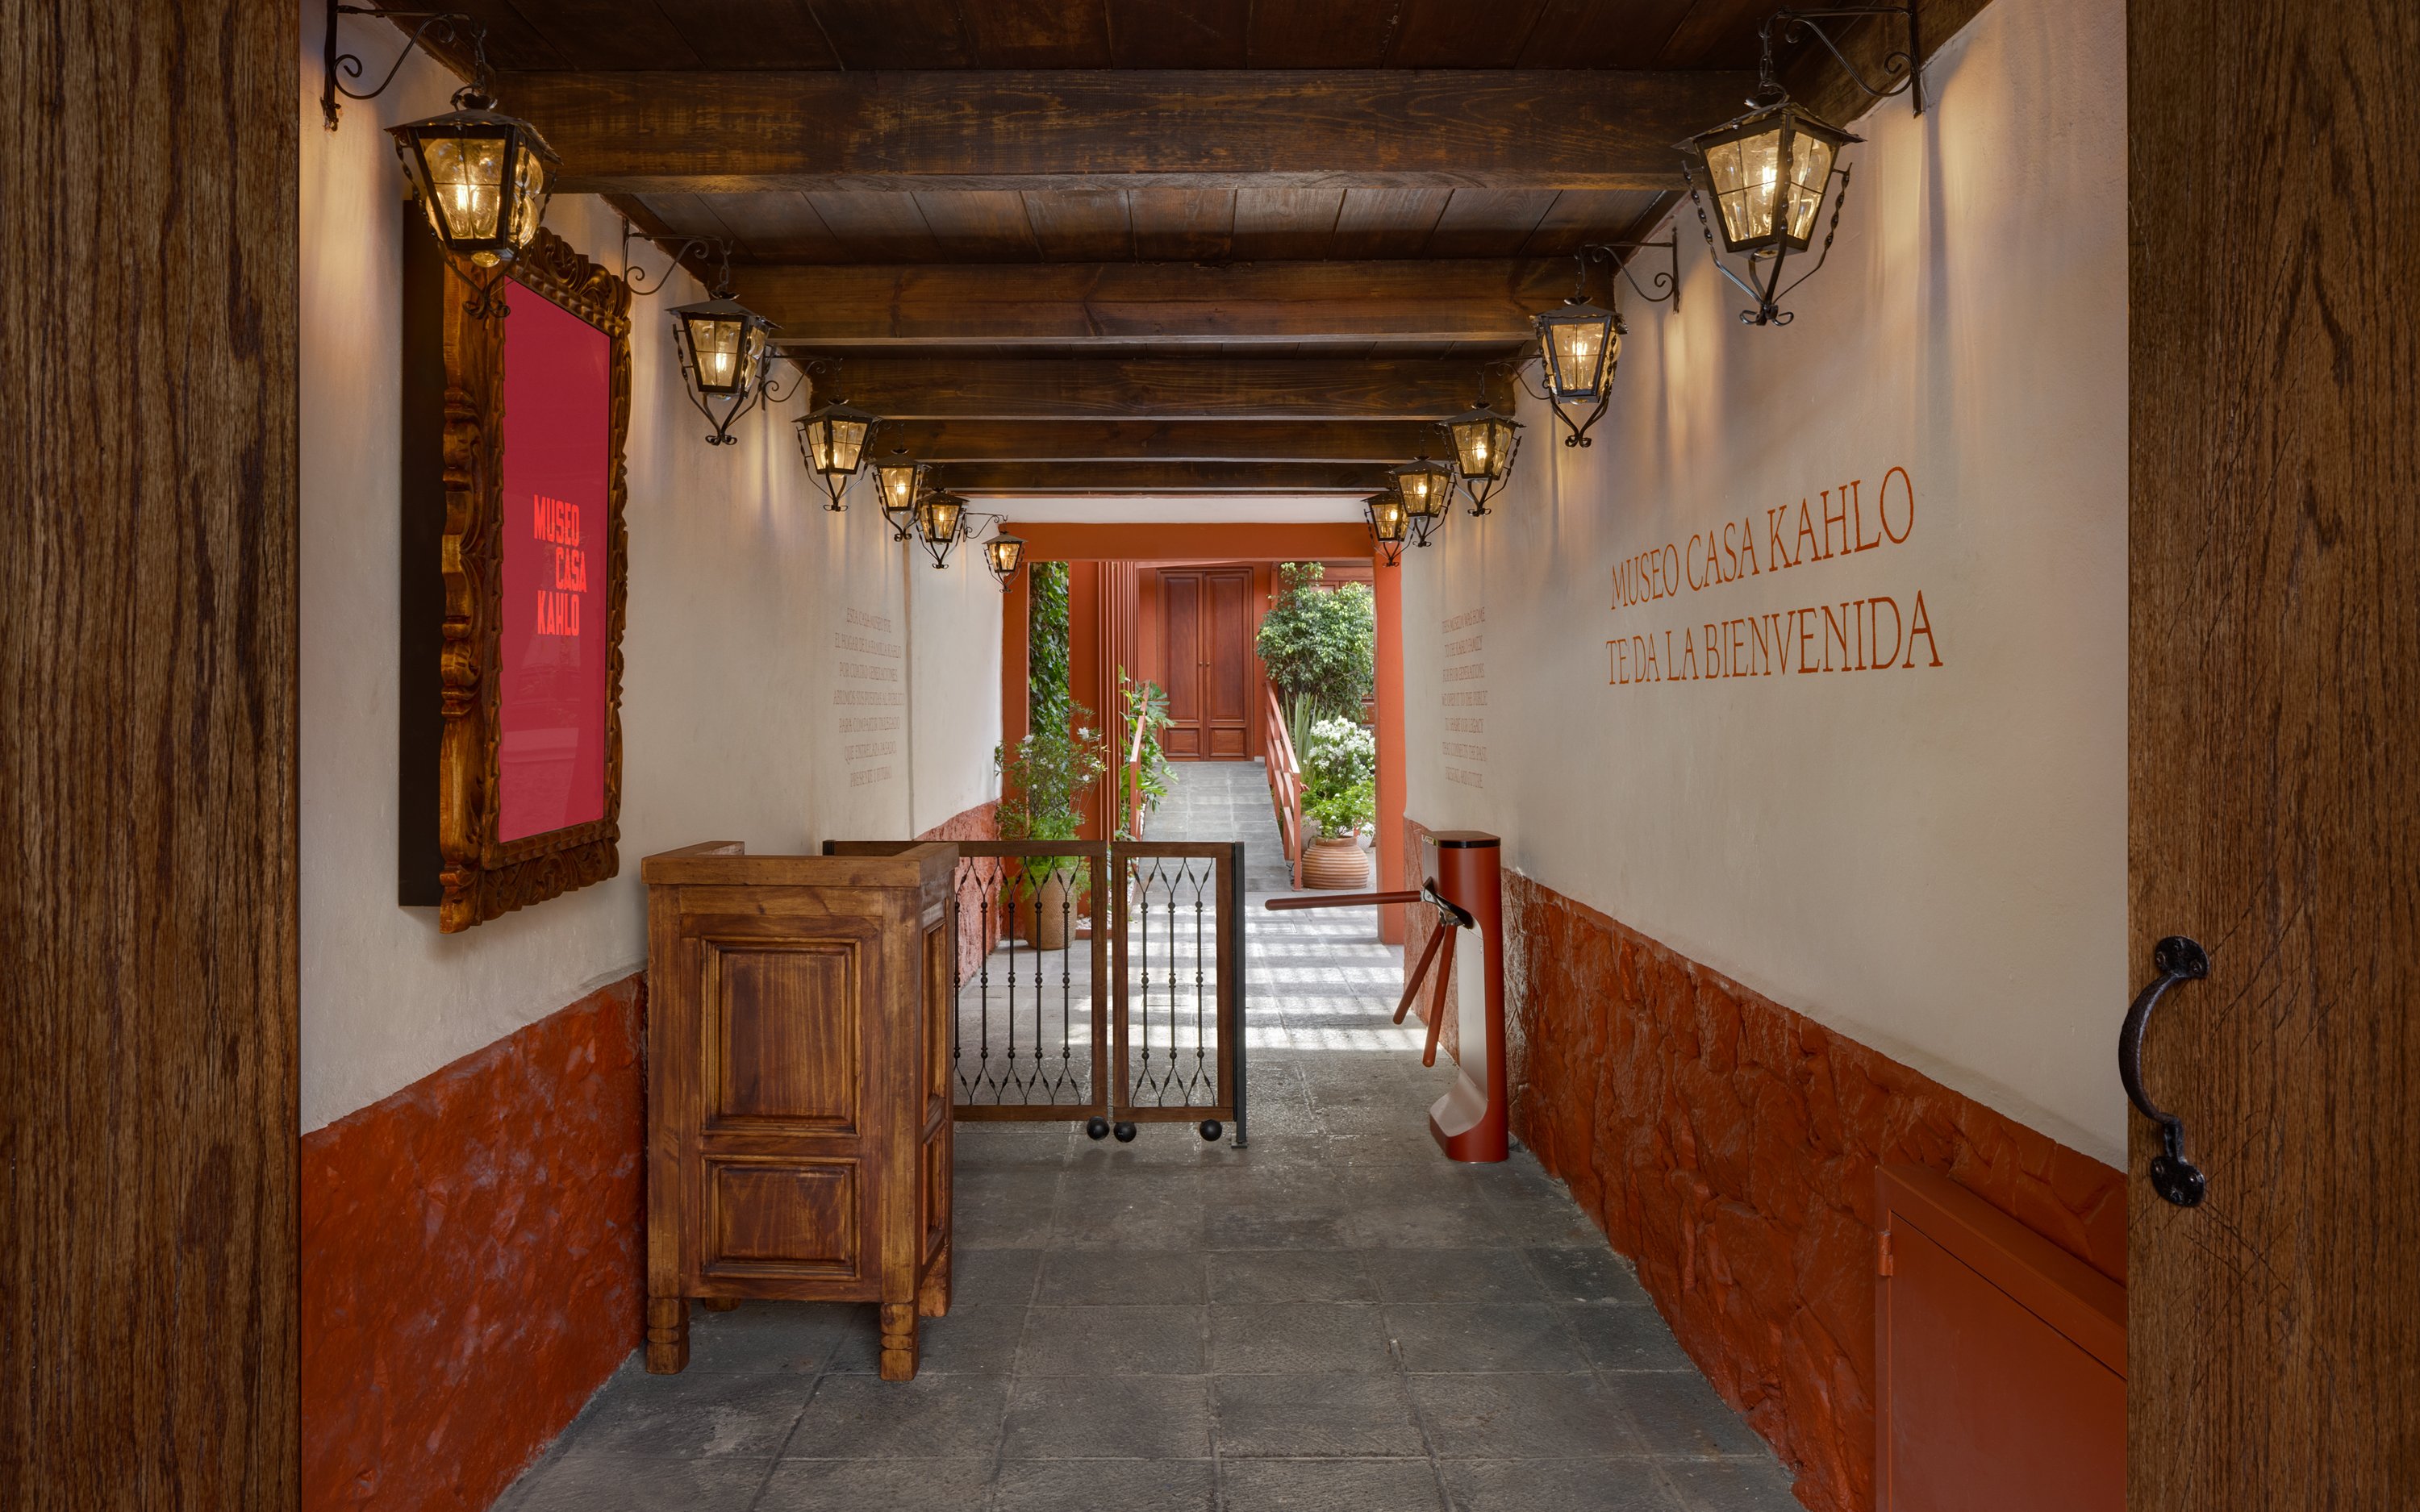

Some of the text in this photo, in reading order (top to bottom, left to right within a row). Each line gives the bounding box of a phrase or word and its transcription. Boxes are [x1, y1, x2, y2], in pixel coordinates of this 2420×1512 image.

[533, 494, 580, 548] MUSEO
[1611, 466, 1914, 610] MUSEO CASA KAHLO
[555, 546, 587, 593] CASA
[537, 589, 580, 636] KAHLO
[835, 633, 841, 648] EL
[1605, 589, 1943, 685] TE DA LA BIENVENIDA
[840, 662, 849, 678] POR
